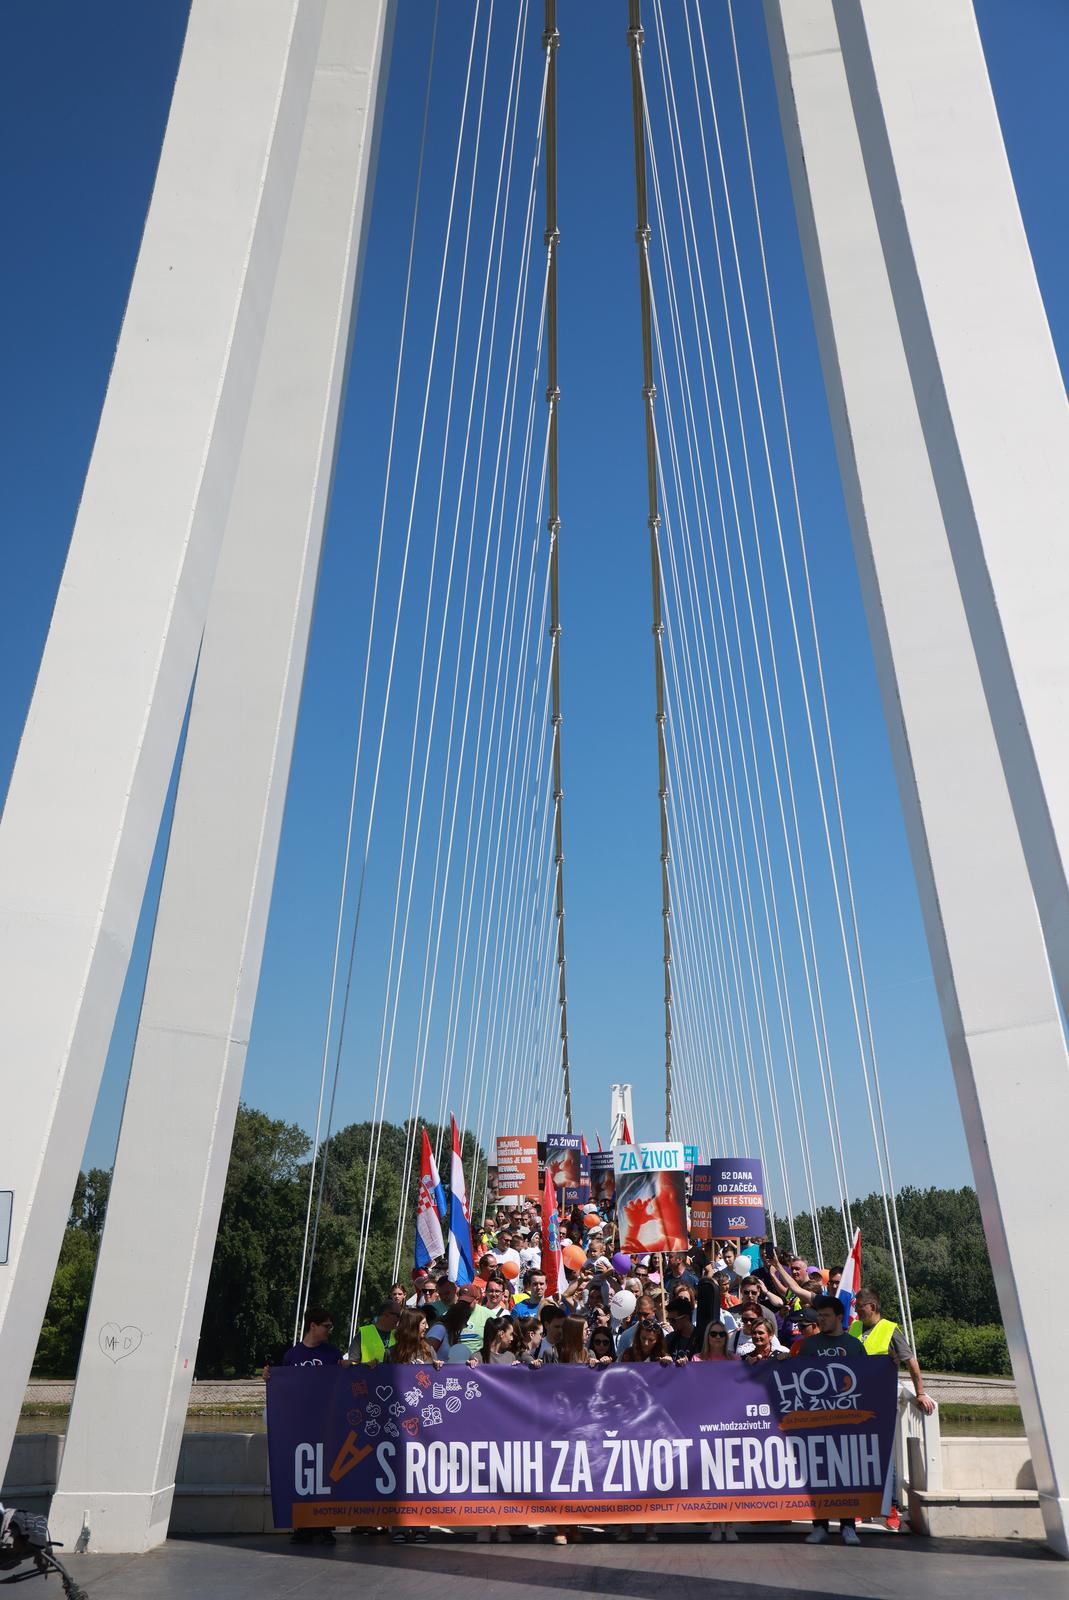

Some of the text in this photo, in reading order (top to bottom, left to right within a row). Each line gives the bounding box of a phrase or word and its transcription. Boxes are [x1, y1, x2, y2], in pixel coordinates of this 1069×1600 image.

[549, 1136, 579, 1147] ZA ŽIVOT
[619, 1152, 638, 1171] ZA
[641, 1147, 679, 1170] ŽIVOT
[721, 1171, 753, 1180] 52 DANA
[717, 1182, 757, 1192] OD ZAČEĆA
[713, 1195, 762, 1205] DIJETE ŠTUCA
[773, 1362, 857, 1401] HOD
[780, 1393, 862, 1413] ZA ŽIVOT
[699, 1420, 771, 1432] www.hodzazivot.hr
[405, 1440, 544, 1495] ROĐENIH
[550, 1438, 593, 1493] ZA
[602, 1430, 693, 1492] ŽIVOT
[701, 1433, 882, 1491] NEROĐENIH
[382, 1506, 418, 1515] OPUZEN
[425, 1506, 456, 1514] OSIJEK
[464, 1506, 496, 1514] RIJEKA
[503, 1505, 524, 1514] SINJ
[531, 1505, 557, 1513] SISAK
[565, 1504, 614, 1513] SLAVONSKI
[617, 1504, 642, 1512] BROD
[650, 1503, 674, 1512] SPLIT
[681, 1501, 728, 1510] VARAŽDIN
[735, 1501, 778, 1510] VINKOVCI
[784, 1500, 816, 1508] ZADAR
